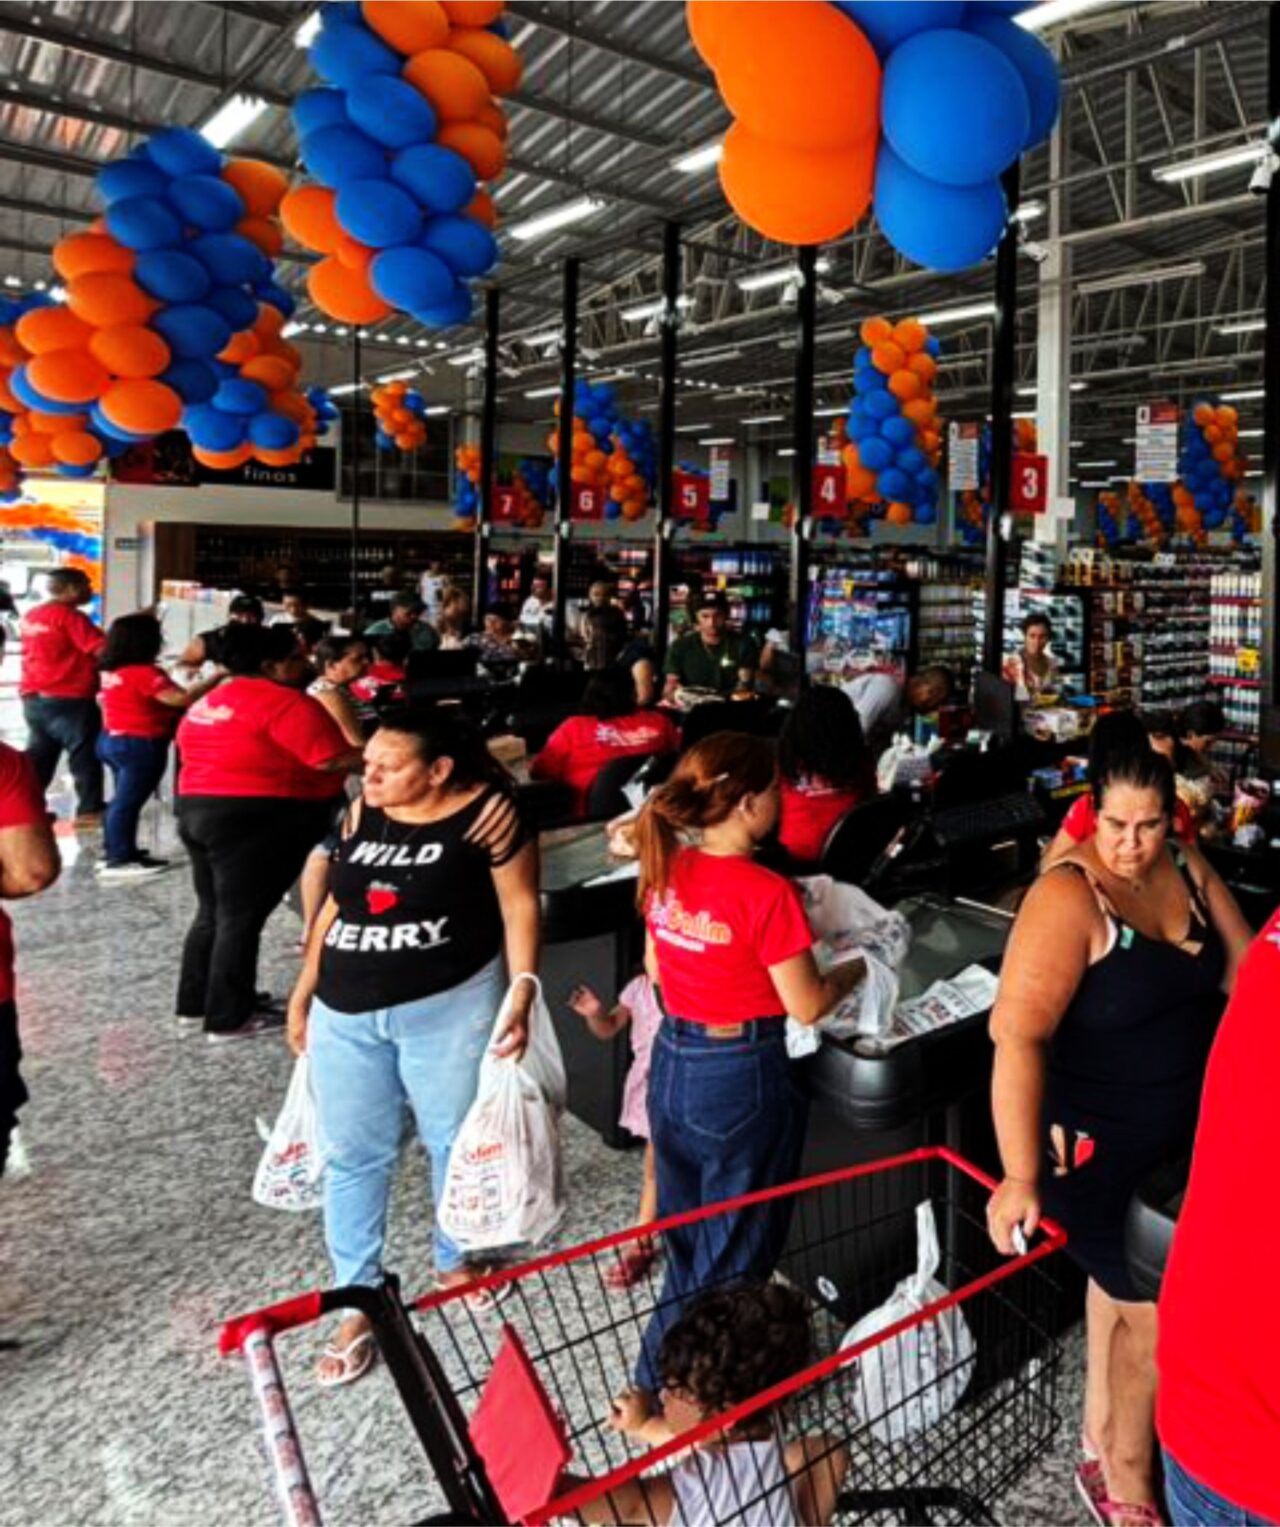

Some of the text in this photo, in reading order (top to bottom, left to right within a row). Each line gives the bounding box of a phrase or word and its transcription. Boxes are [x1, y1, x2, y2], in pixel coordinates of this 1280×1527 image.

[244, 465, 297, 482] finos
[1022, 467, 1039, 499] 3
[579, 490, 594, 512] 6
[681, 484, 698, 508] 5
[820, 475, 836, 503] 4
[501, 495, 513, 514] 7
[348, 841, 443, 867] WILD
